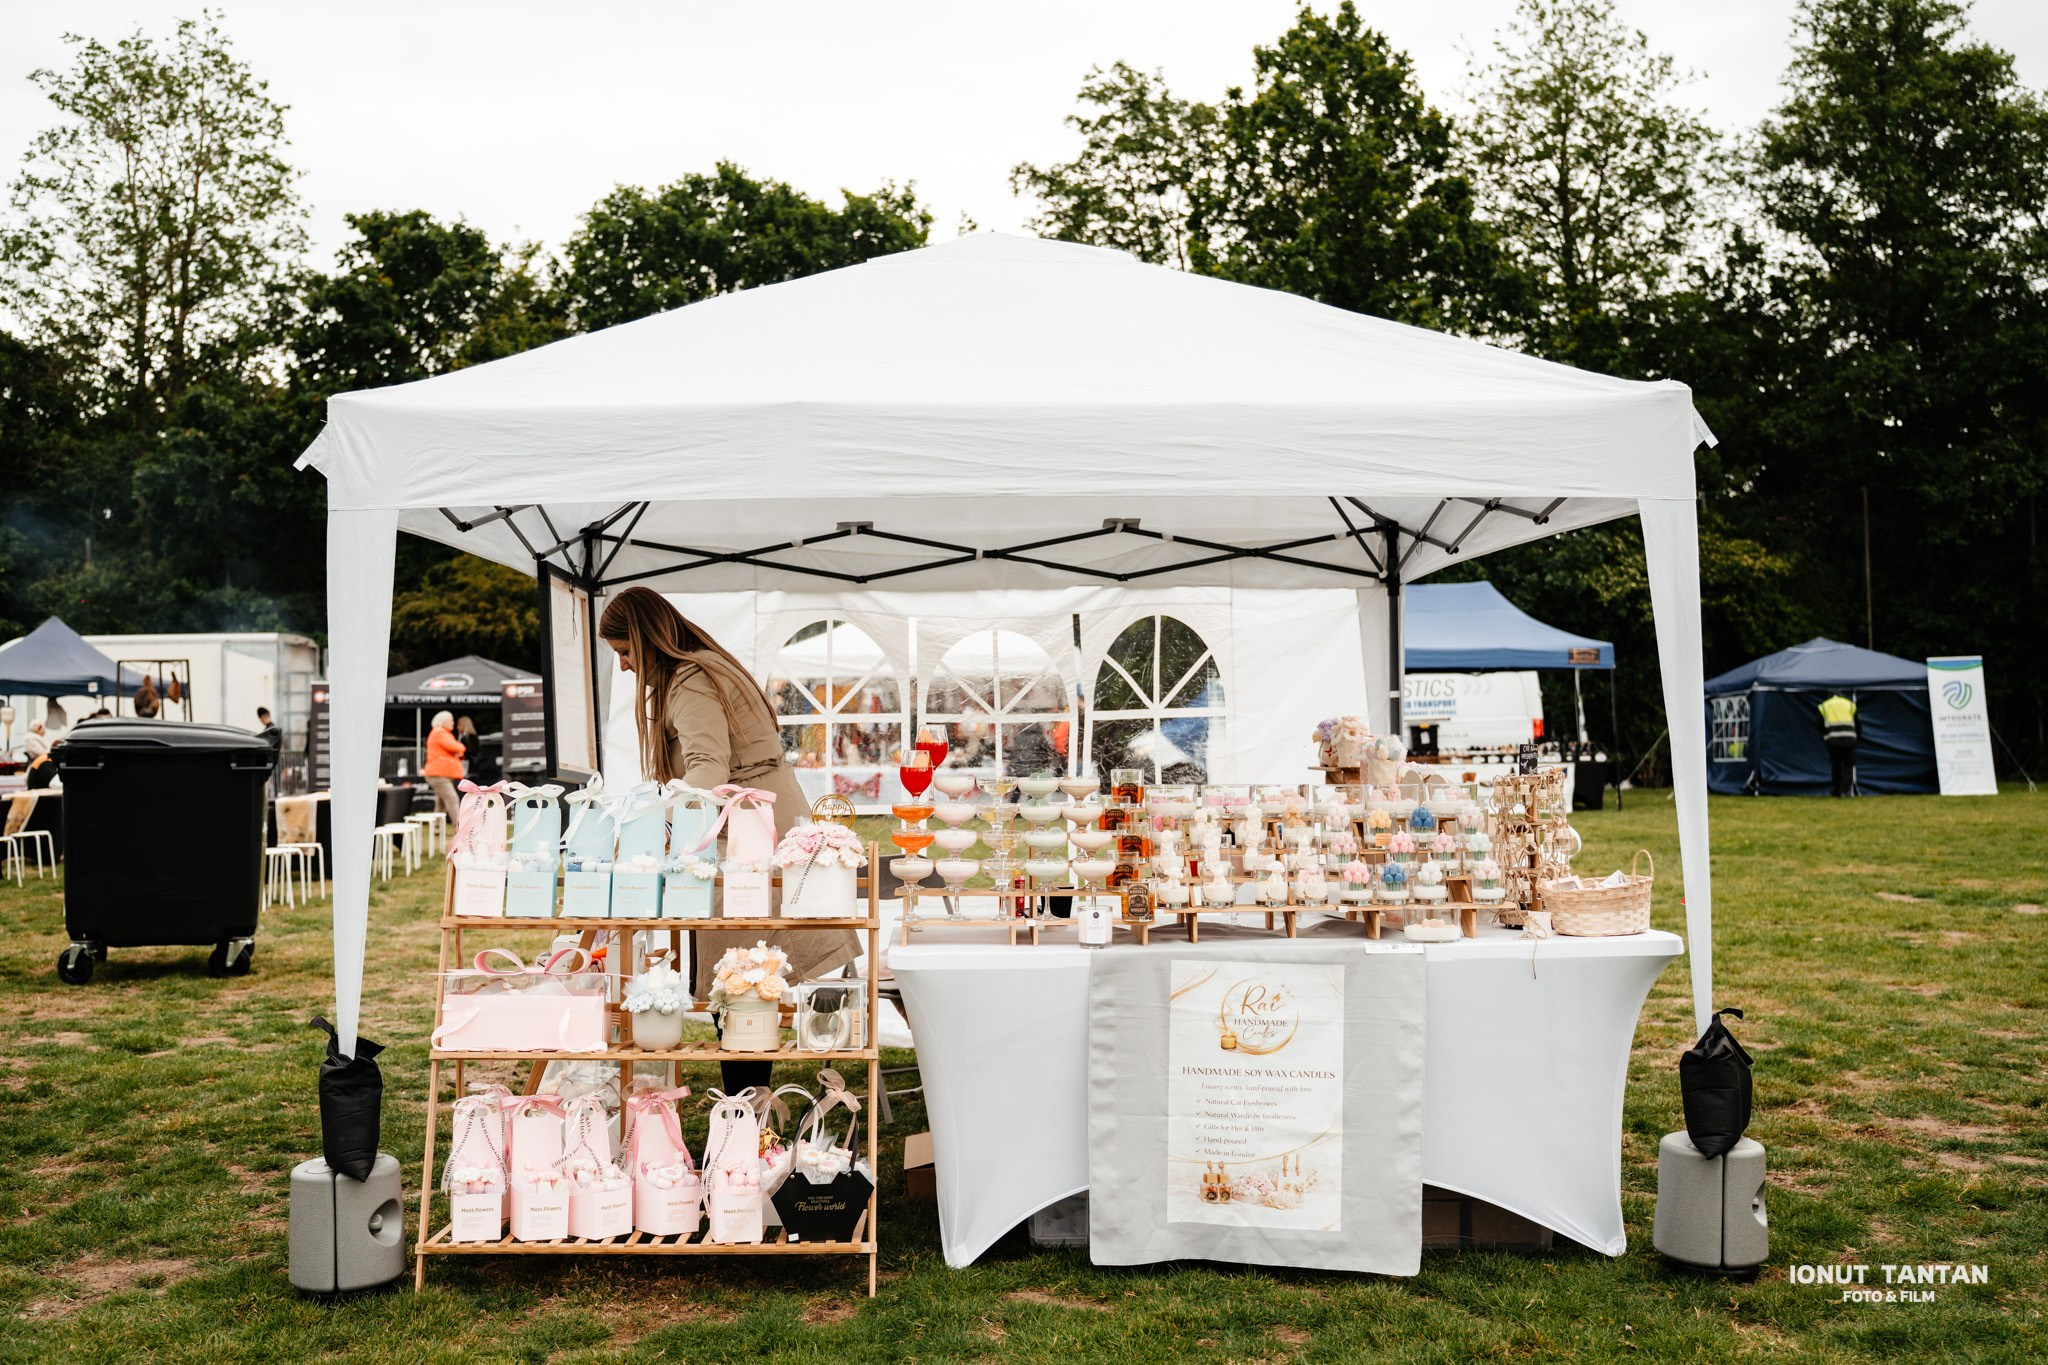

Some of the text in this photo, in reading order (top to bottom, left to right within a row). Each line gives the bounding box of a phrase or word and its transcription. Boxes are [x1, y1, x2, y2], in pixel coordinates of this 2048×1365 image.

[1939, 714, 1982, 722] INTEGRATE
[1240, 985, 1287, 1016] Rai
[1234, 1018, 1288, 1027] HANDMADE
[1243, 1026, 1279, 1040] Candles
[1182, 1066, 1336, 1080] HANDMADE SOY WAX CANDLES
[1200, 1082, 1223, 1091] Luxury
[1204, 1098, 1229, 1106] Natural
[1204, 1111, 1297, 1120] Natural Wardrobe fresheners
[1203, 1123, 1220, 1131] Gifts
[1220, 1123, 1229, 1131] for
[1203, 1148, 1223, 1156] Made
[1231, 1150, 1256, 1158] London
[601, 1202, 627, 1211] Meet.flowers
[795, 1201, 846, 1211] Flower world
[723, 1207, 755, 1215] Meet.flowers
